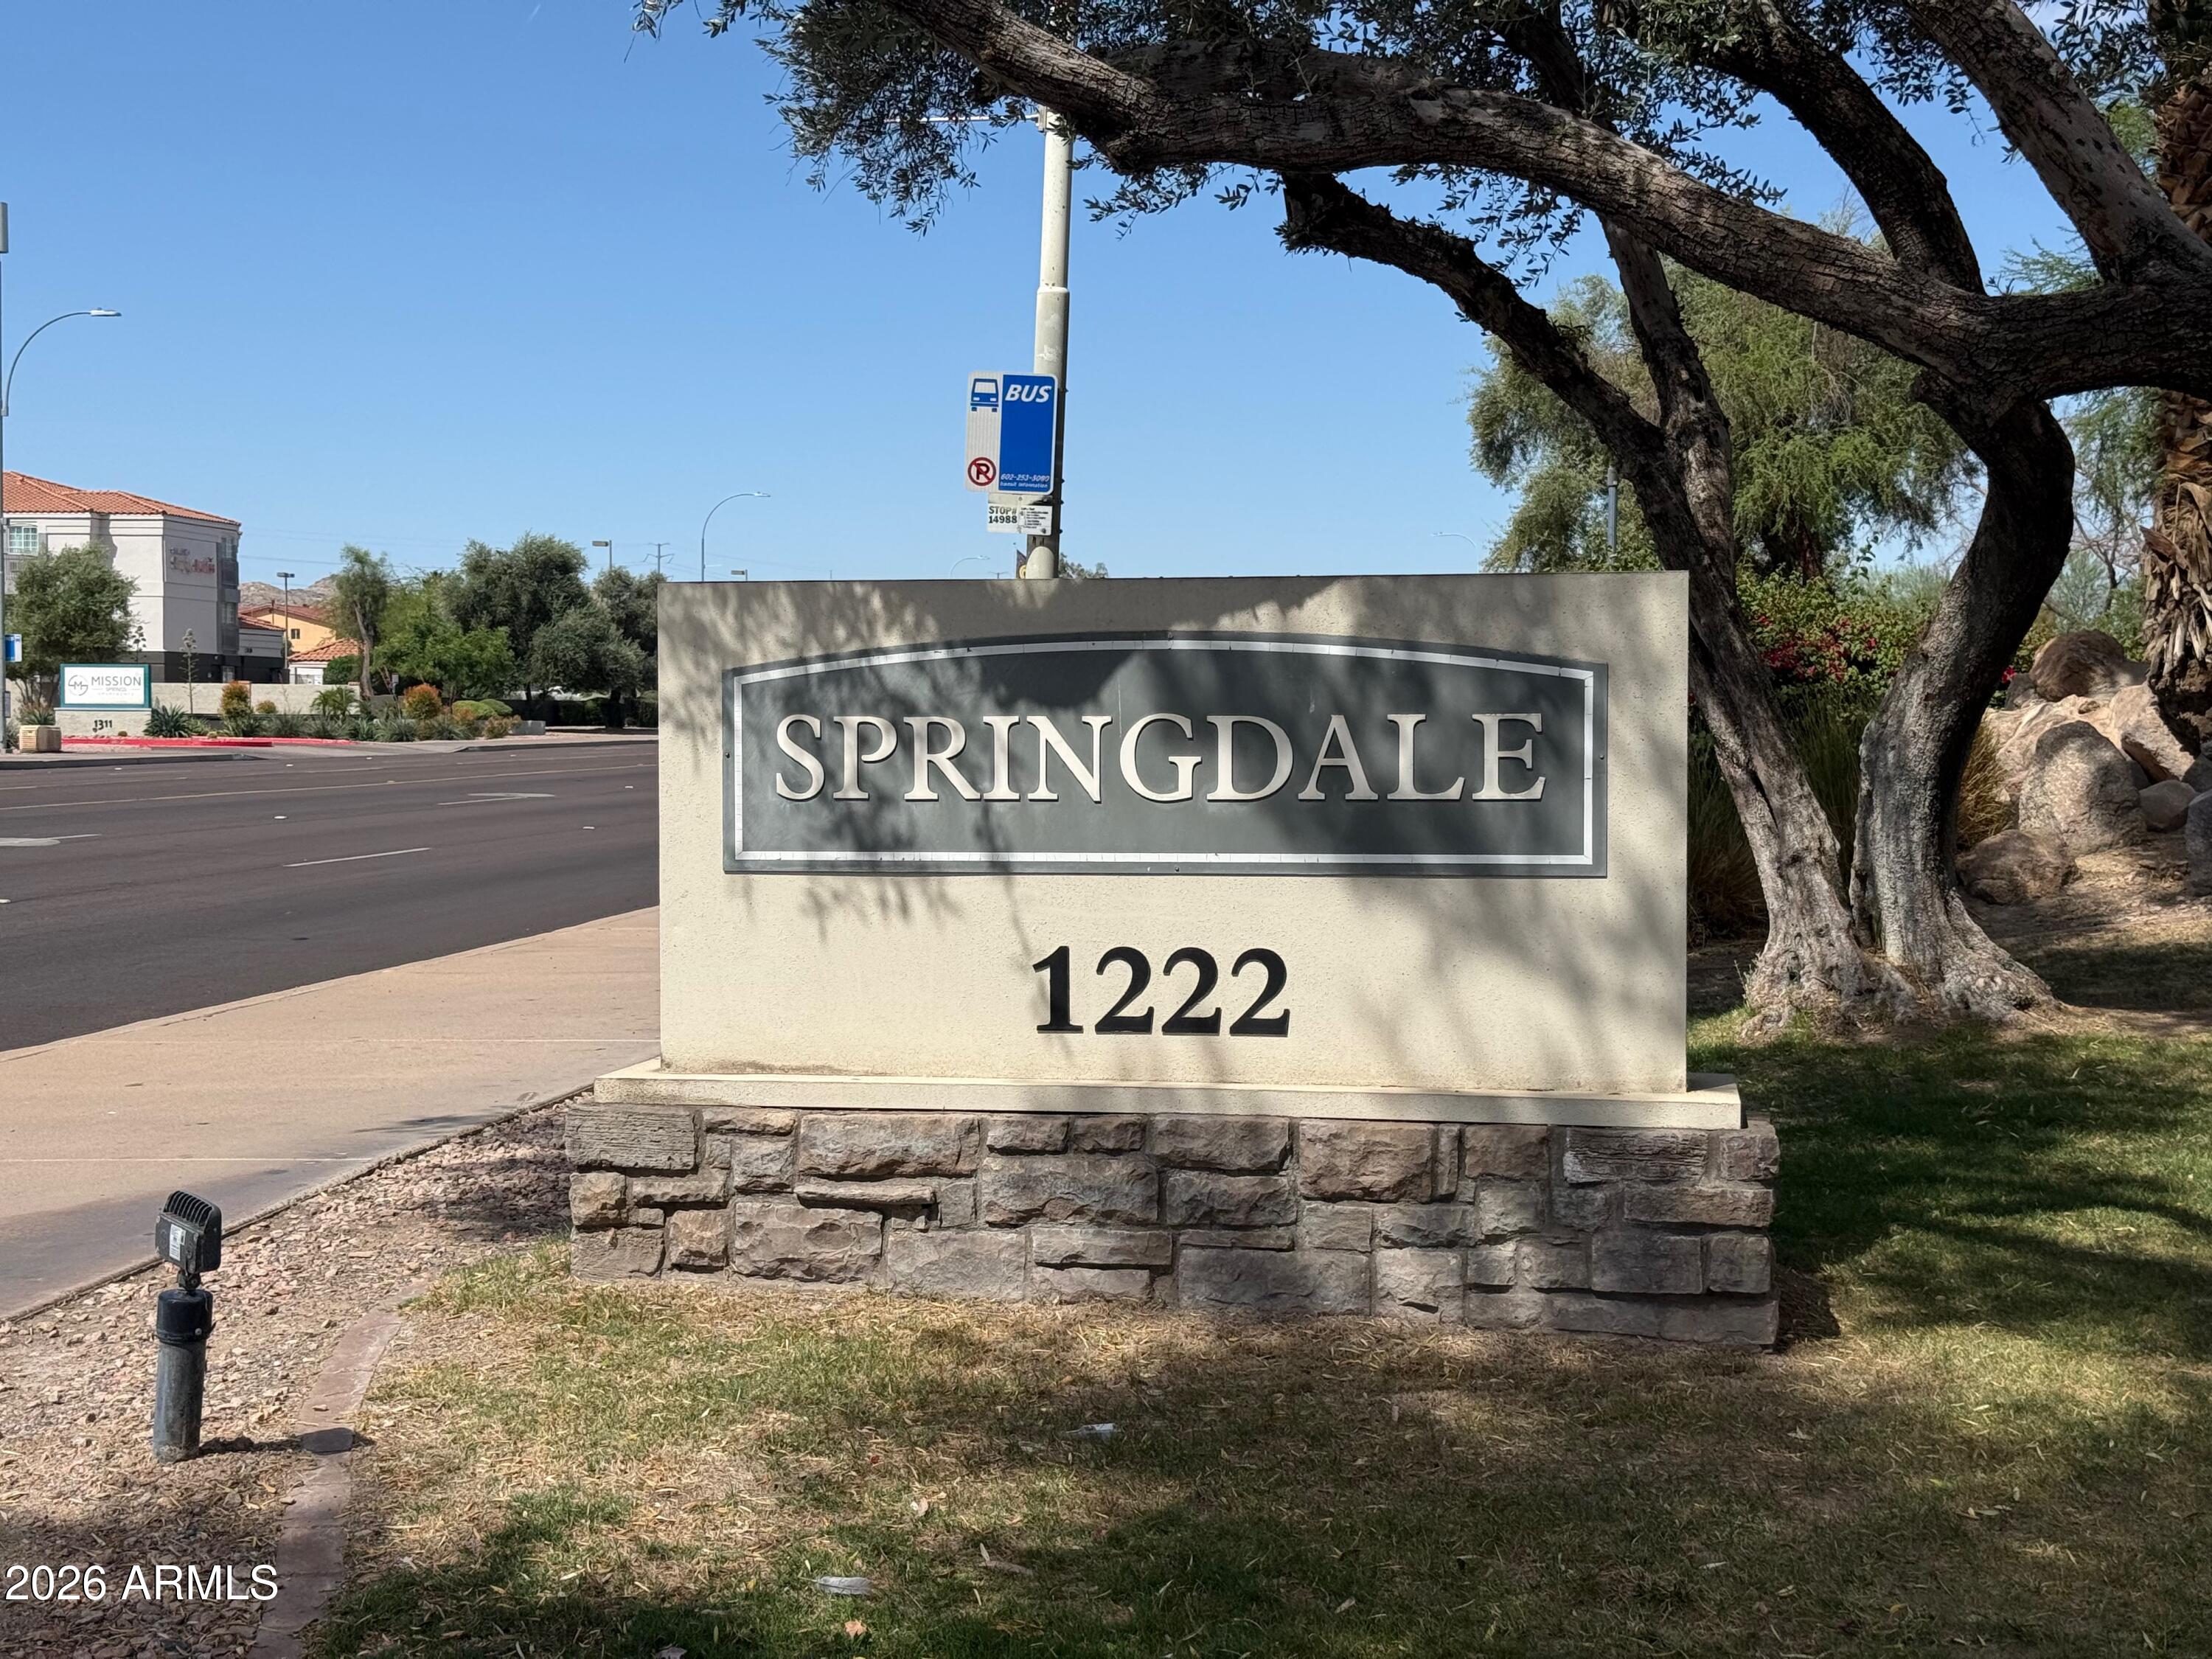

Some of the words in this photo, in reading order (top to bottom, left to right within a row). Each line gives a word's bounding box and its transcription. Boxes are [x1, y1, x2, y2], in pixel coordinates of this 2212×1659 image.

[1004, 384, 1052, 403] BUS
[989, 506, 1018, 515] STOP#
[989, 515, 1018, 524] 14988
[91, 676, 142, 686] MISSION
[94, 720, 113, 730] 1311
[776, 713, 1546, 801] SPRINGDALE
[1032, 945, 1290, 1037] 1222
